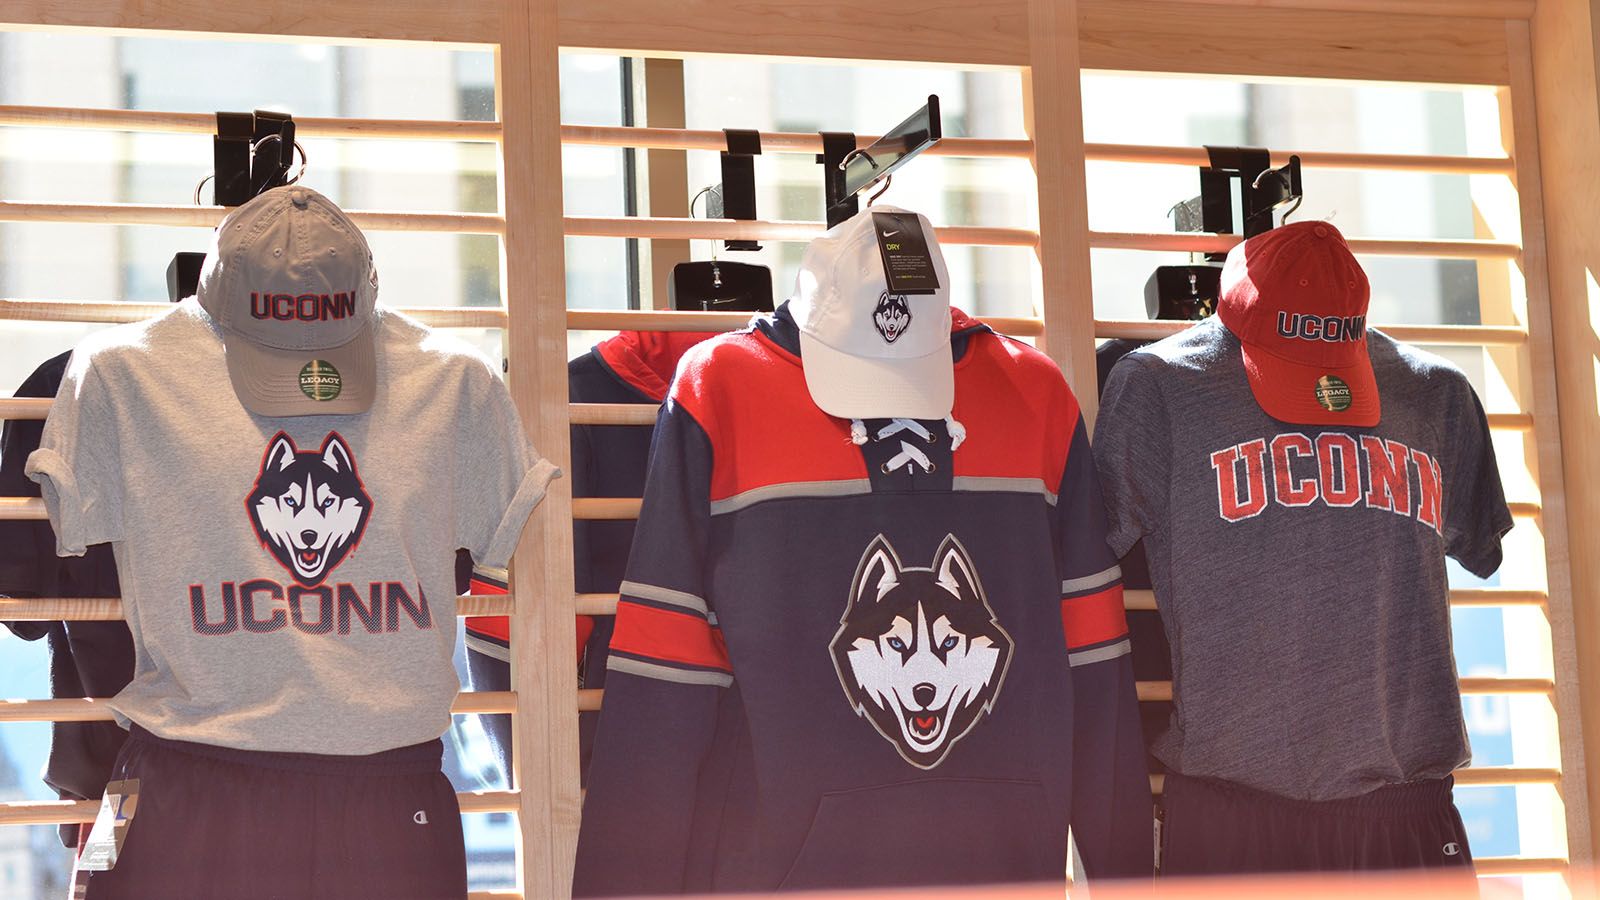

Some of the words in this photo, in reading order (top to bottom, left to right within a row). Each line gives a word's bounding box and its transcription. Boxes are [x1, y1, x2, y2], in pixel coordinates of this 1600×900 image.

[886, 243, 900, 251] DRY
[250, 290, 356, 322] UCONN
[300, 377, 340, 385] LEGACY
[1316, 389, 1350, 397] LEGACY
[1210, 432, 1443, 537] UCONN
[188, 578, 433, 636] UCONN
